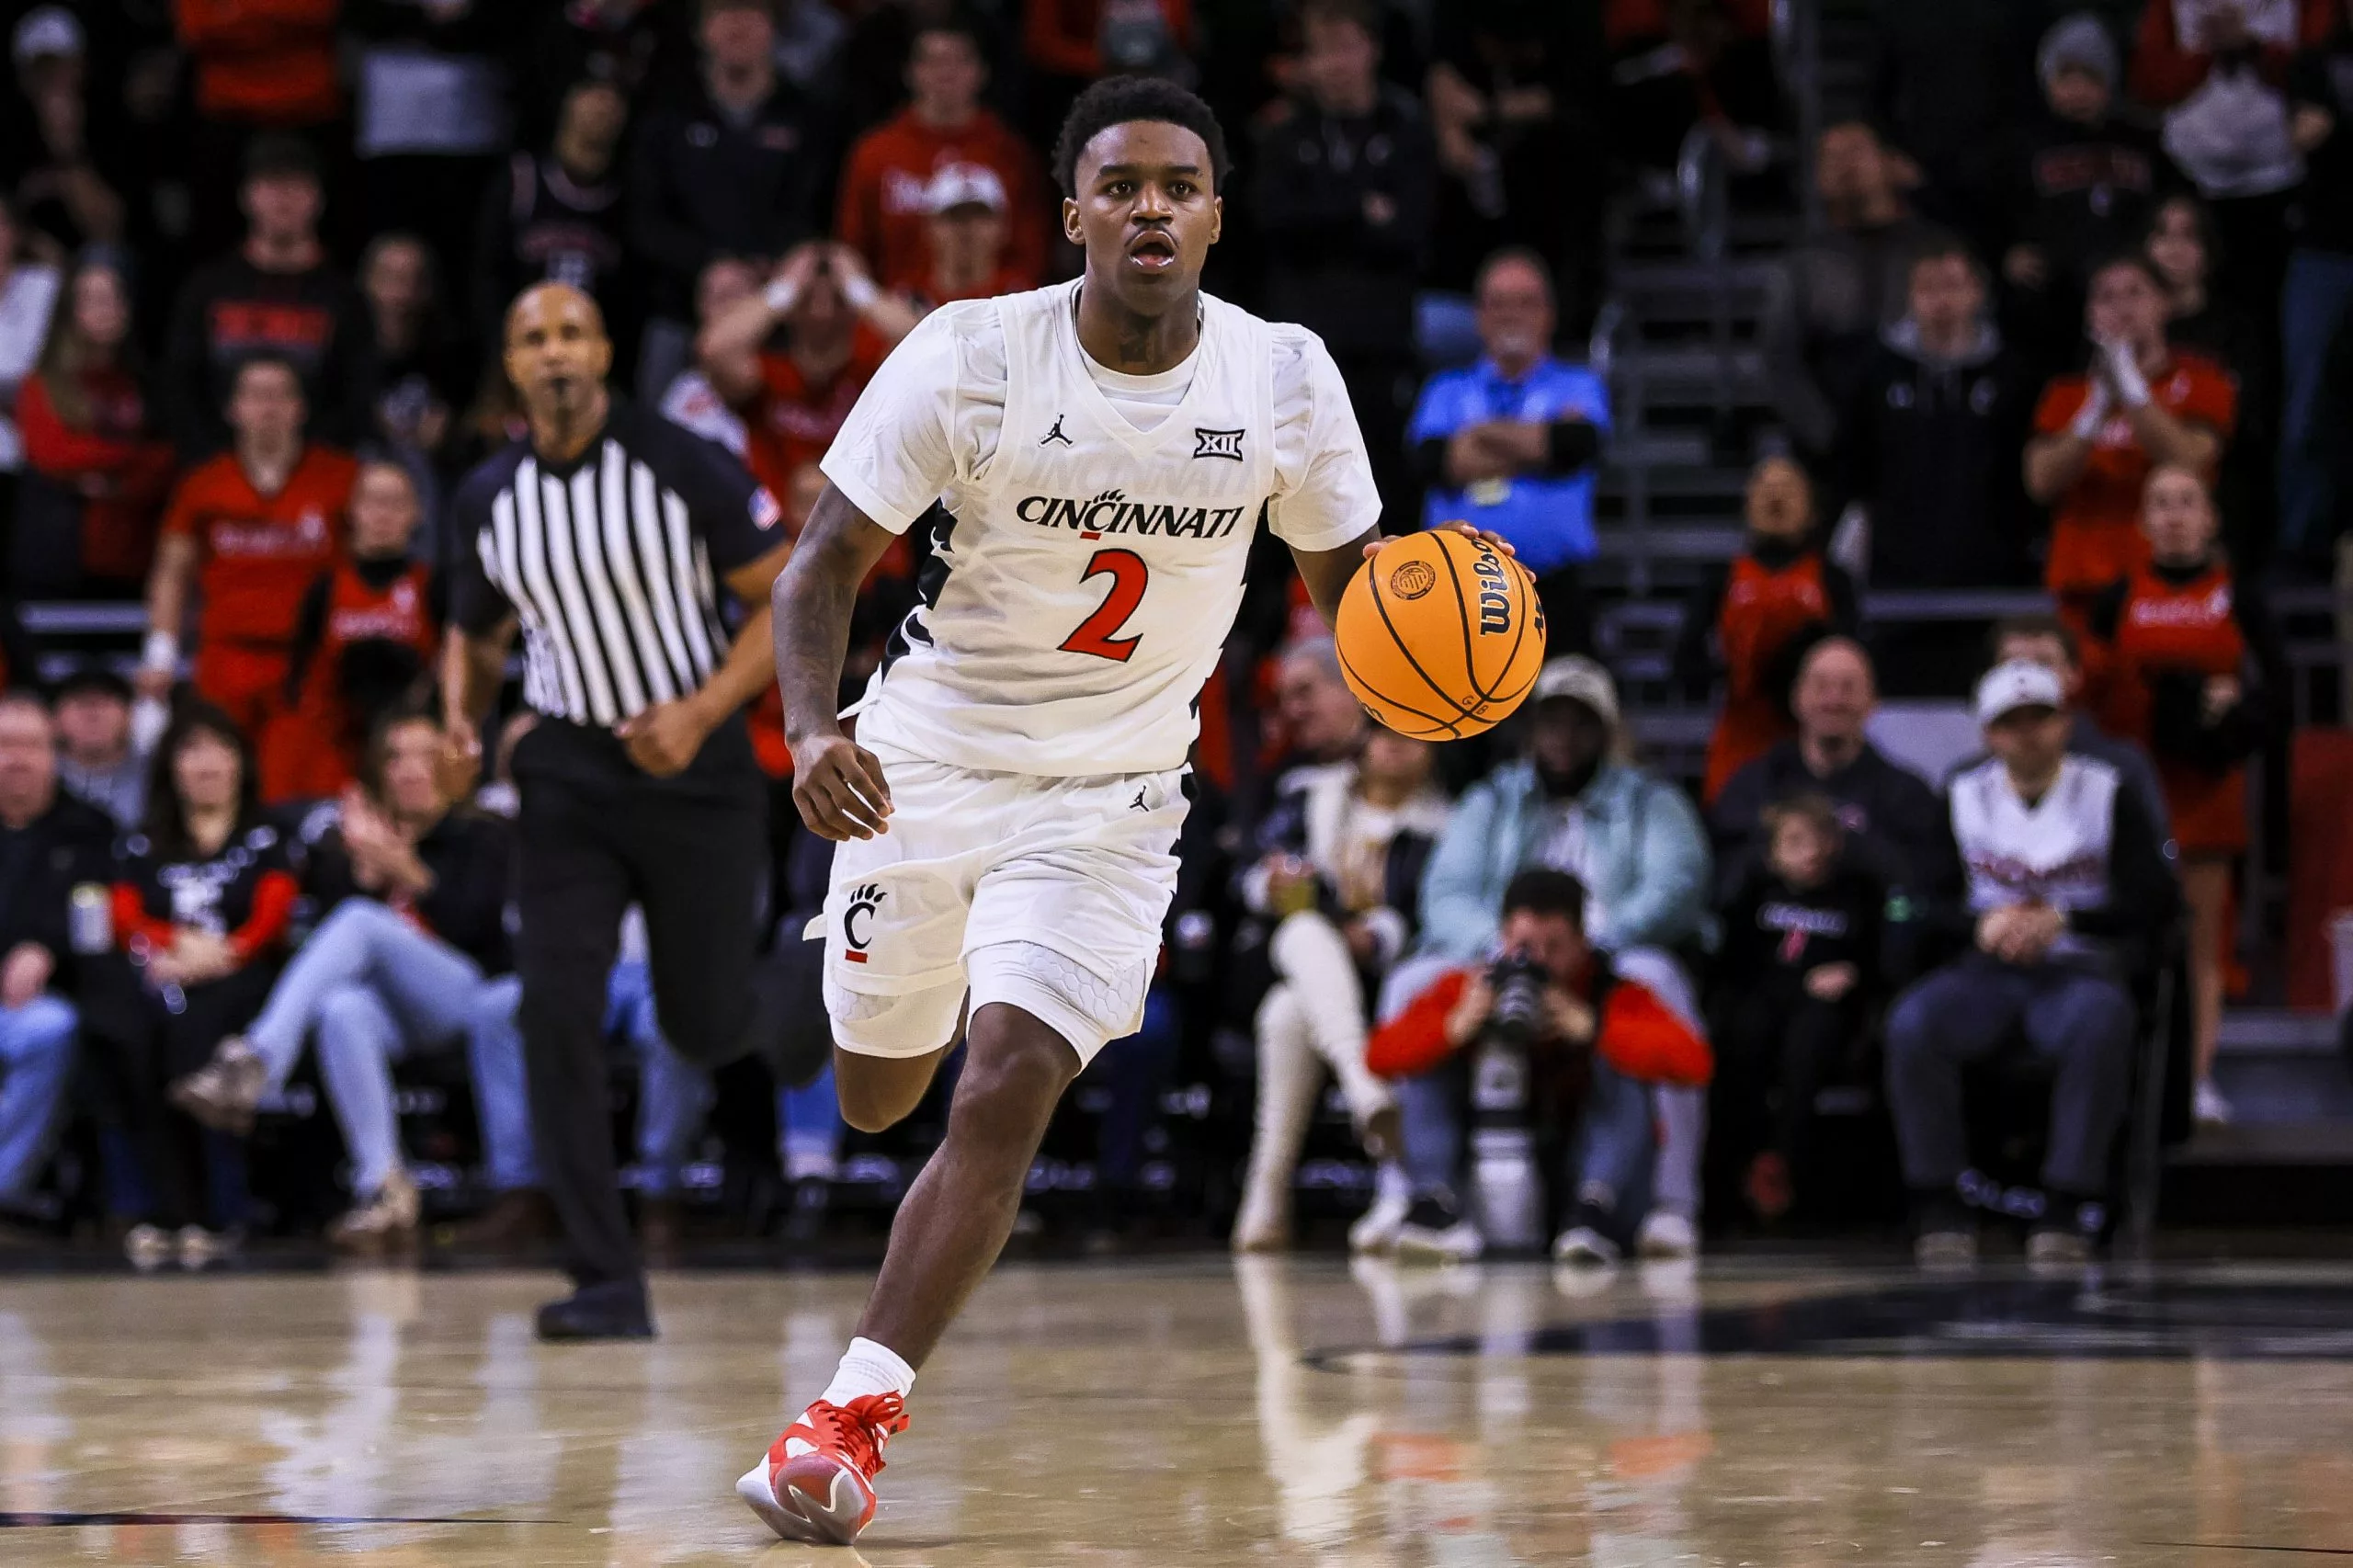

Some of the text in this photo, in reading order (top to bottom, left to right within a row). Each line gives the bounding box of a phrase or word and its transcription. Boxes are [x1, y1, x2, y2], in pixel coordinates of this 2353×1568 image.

[1197, 432, 1241, 458] XII
[1017, 494, 1245, 539] CINCINNATI
[1056, 548, 1149, 663] 2
[1471, 536, 1511, 637] Wilso
[844, 900, 878, 952] C
